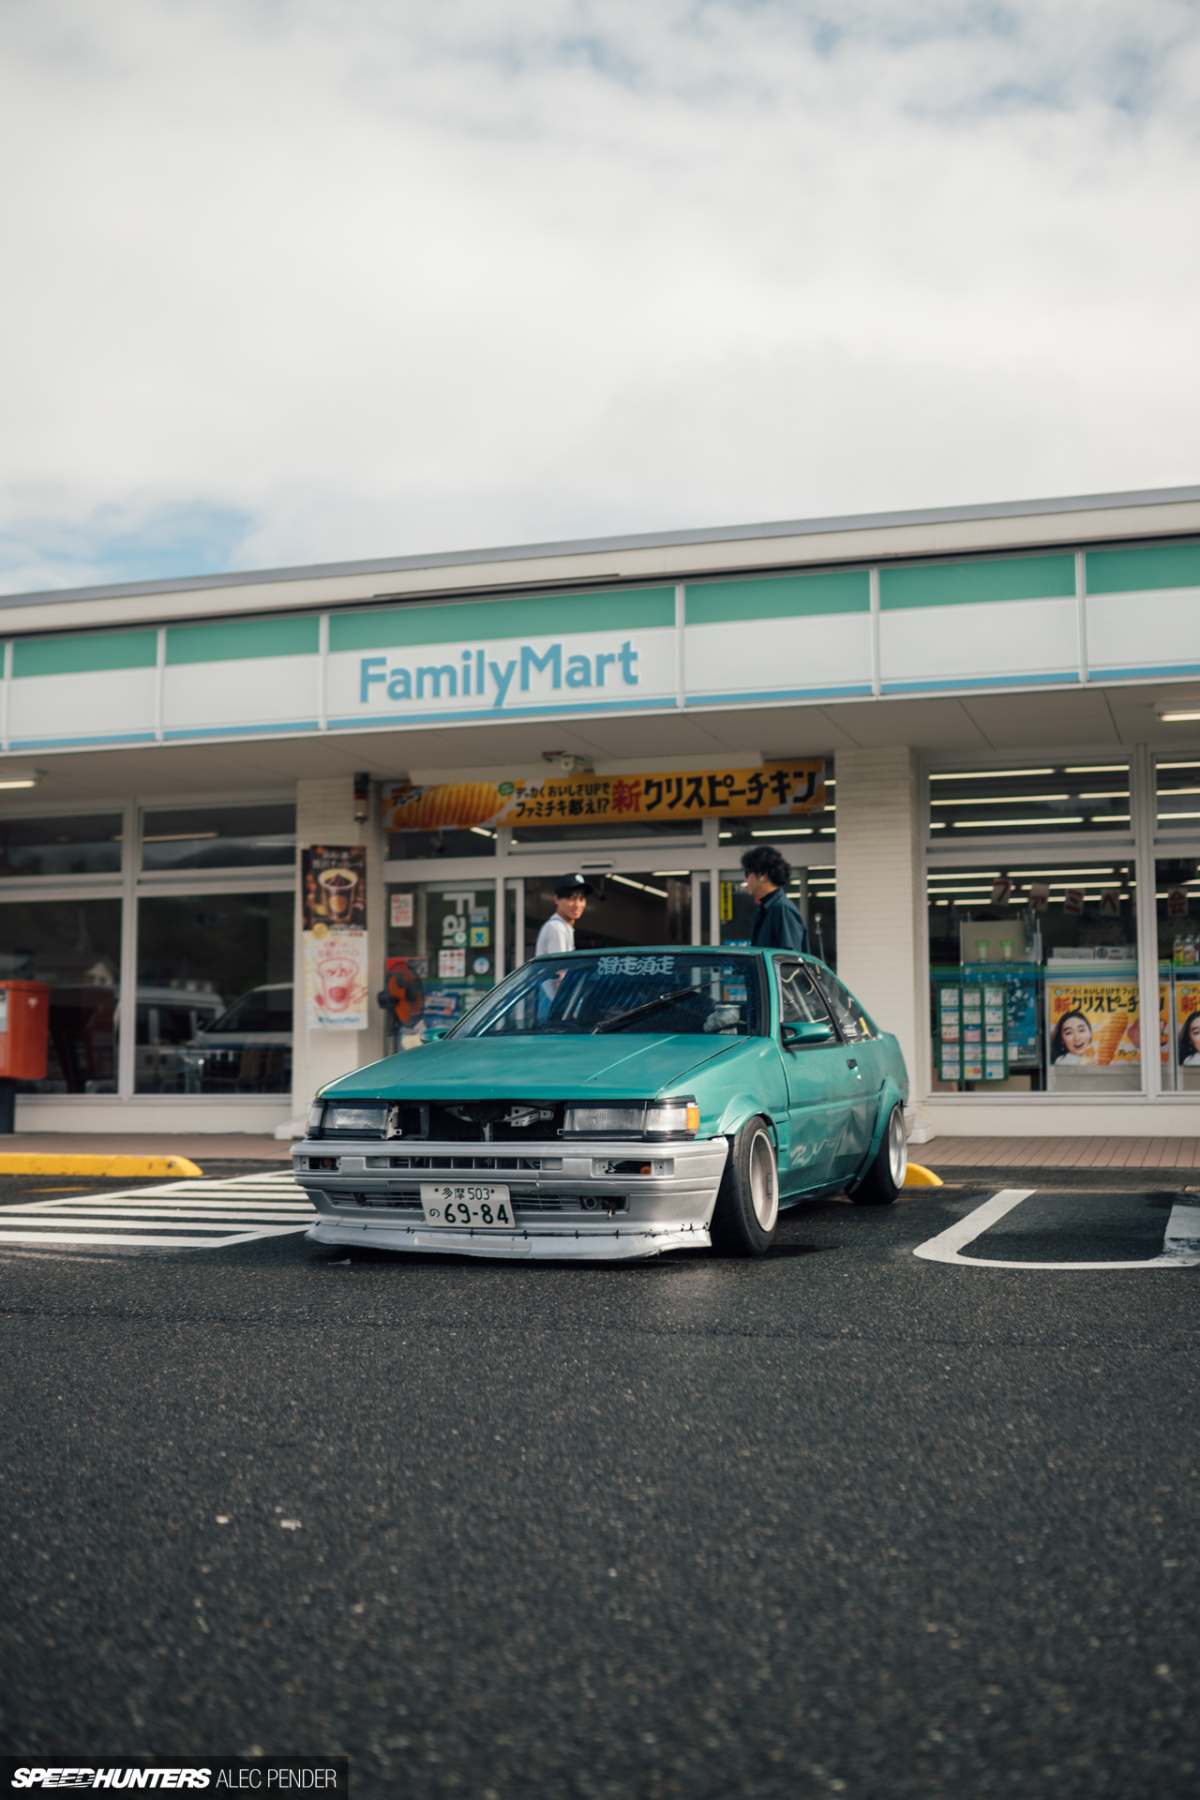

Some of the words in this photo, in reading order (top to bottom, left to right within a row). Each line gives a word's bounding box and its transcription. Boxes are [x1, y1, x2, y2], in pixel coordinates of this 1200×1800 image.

[360, 640, 638, 708] FamilyMart
[441, 1187, 465, 1199] 多摩
[467, 1187, 490, 1200] 503
[429, 1208, 441, 1218] の
[444, 1203, 509, 1224] 69-84
